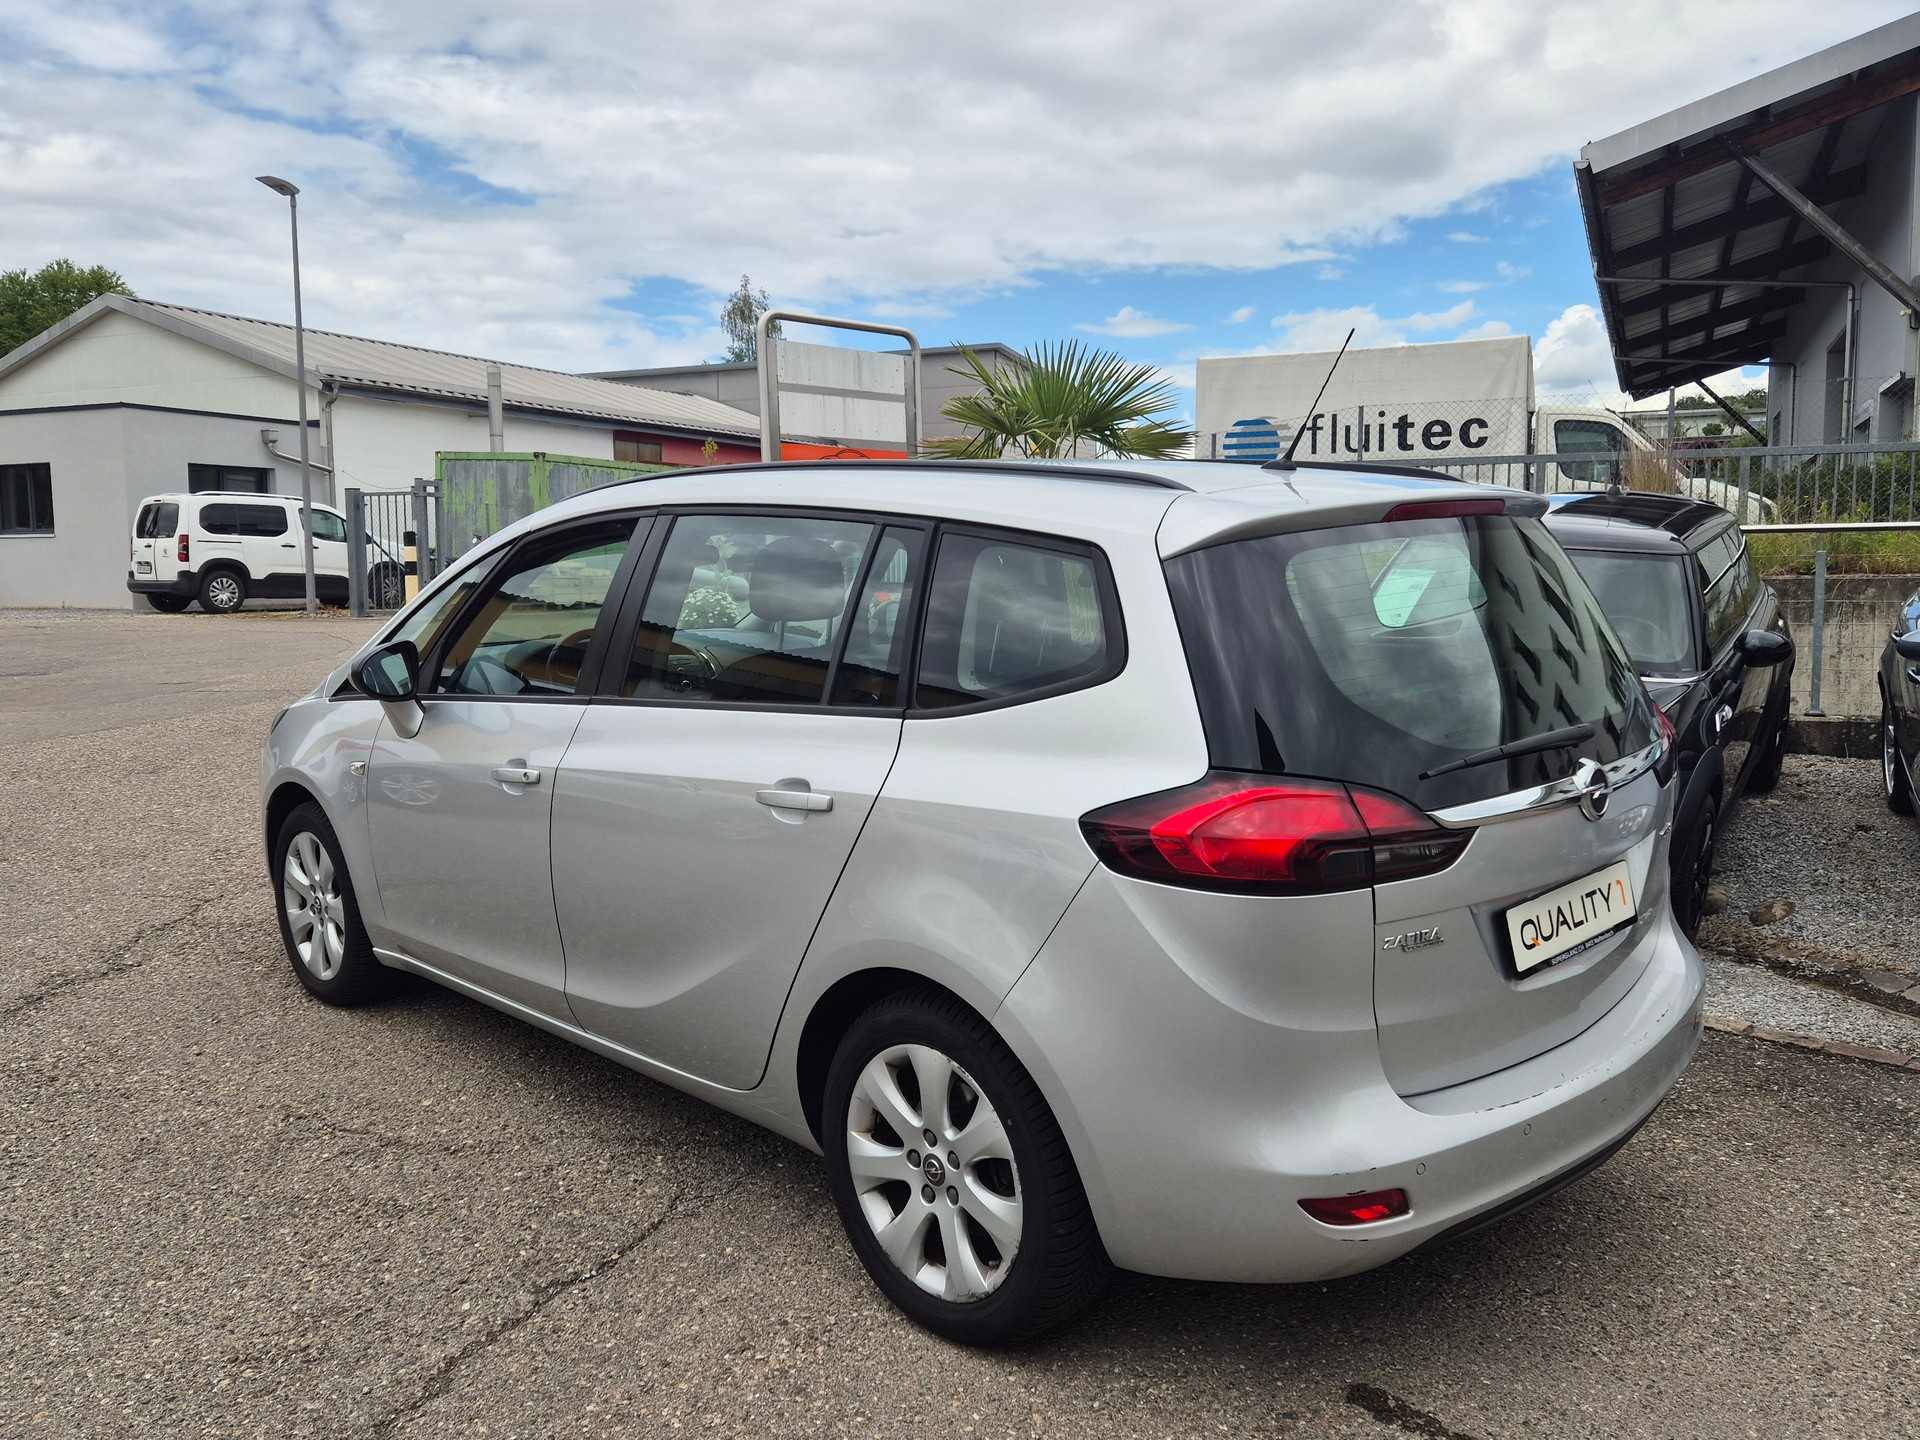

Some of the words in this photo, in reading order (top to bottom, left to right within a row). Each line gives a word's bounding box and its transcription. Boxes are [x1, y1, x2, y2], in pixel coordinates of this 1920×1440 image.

[1307, 410, 1489, 454] fluitec
[1520, 882, 1612, 950] QUALITY
[1615, 879, 1627, 905] 1
[1383, 926, 1442, 949] ZAFIRA
